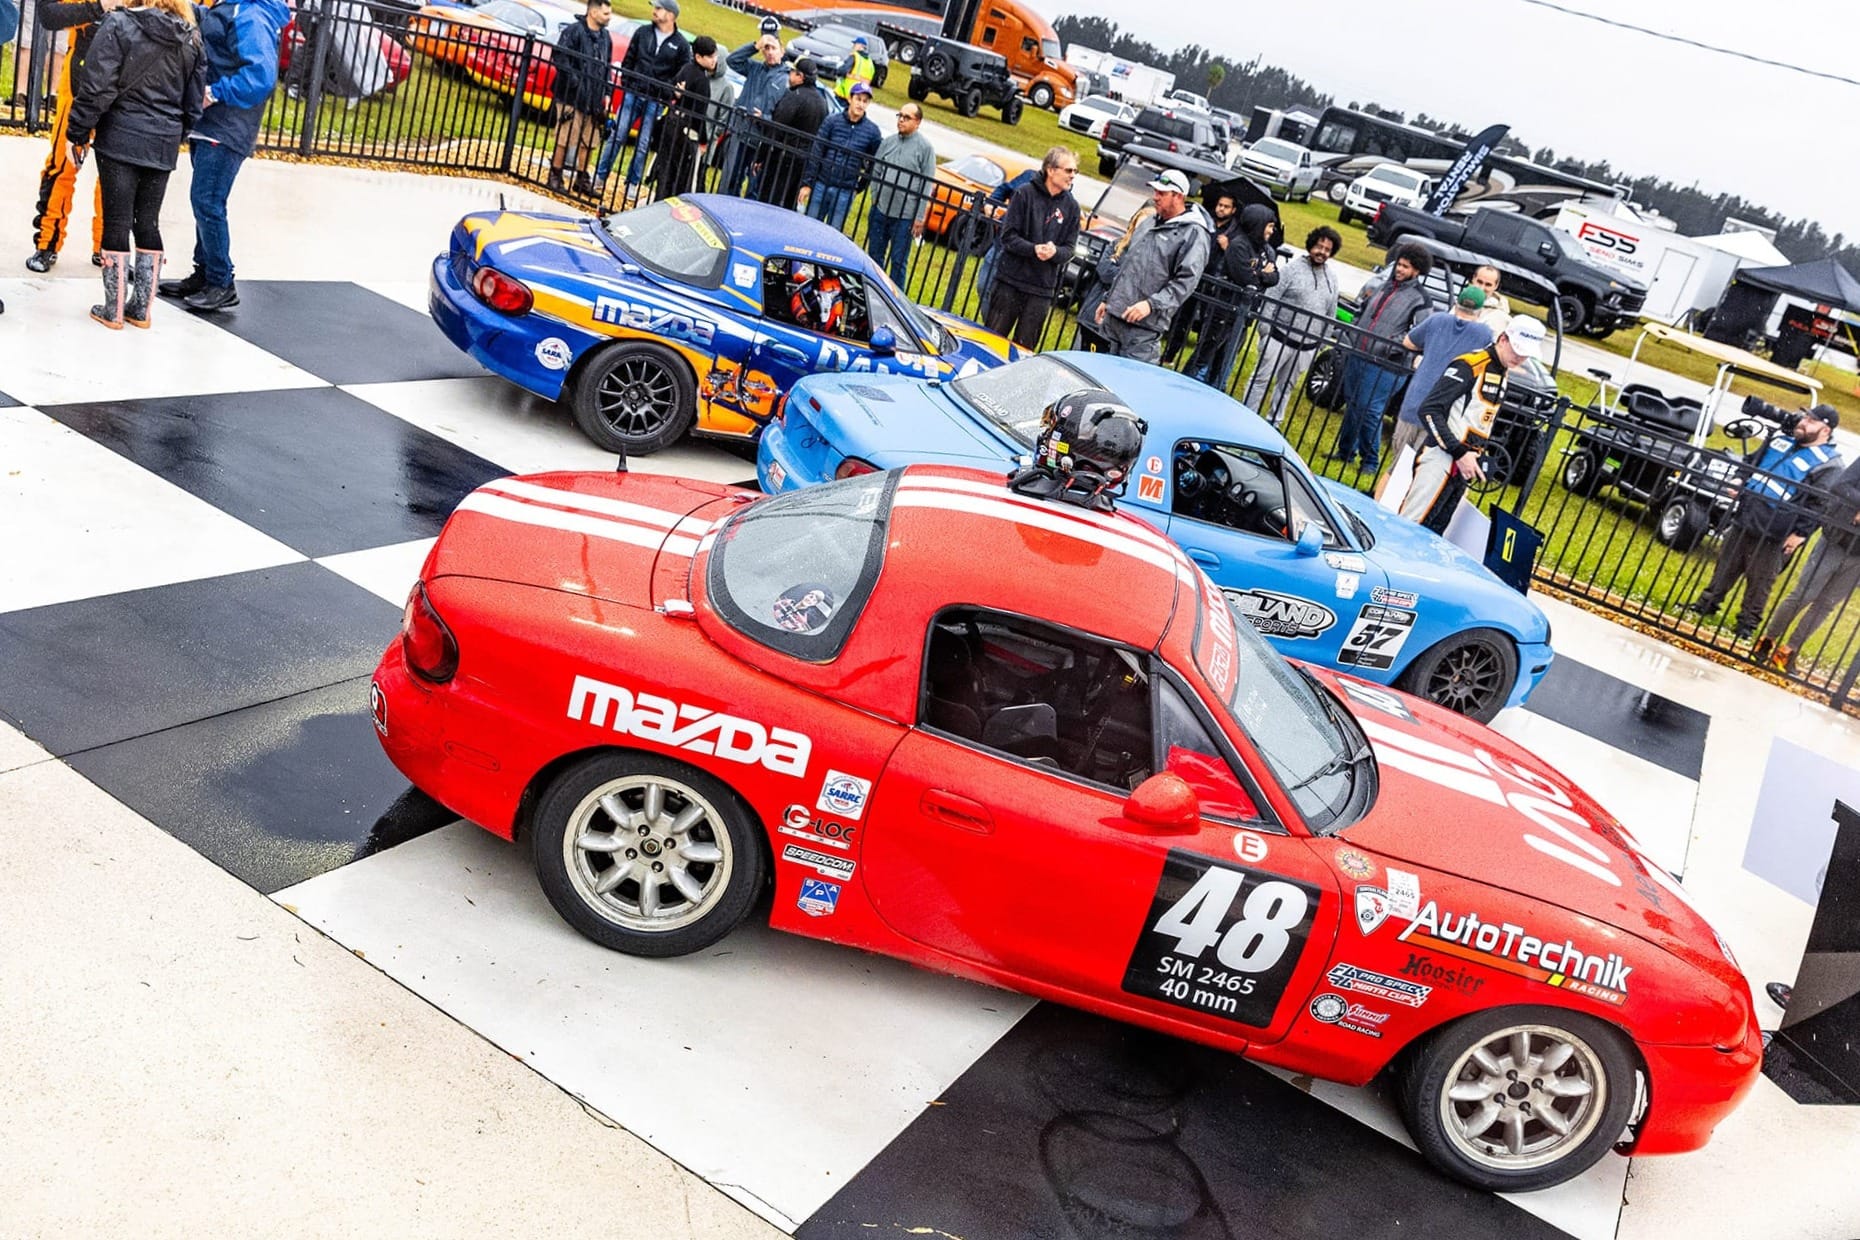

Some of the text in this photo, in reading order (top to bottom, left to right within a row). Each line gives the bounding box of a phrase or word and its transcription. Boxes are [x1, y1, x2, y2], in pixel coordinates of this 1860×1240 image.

[1433, 150, 1473, 200] RENTAL
[1351, 624, 1404, 650] 57
[784, 804, 856, 842] G-LOC
[1242, 834, 1260, 859] E
[1153, 865, 1309, 974] 48
[1397, 900, 1633, 993] AutoTechnik
[1157, 956, 1257, 995] SM 2465
[1359, 972, 1383, 984] PRO
[1384, 979, 1416, 993] SPEC
[1399, 953, 1485, 992] Hoosier
[1159, 978, 1238, 1013] 40 mm
[1352, 982, 1412, 1003] MIATA CUP
[1569, 981, 1619, 1001] RACING
[1337, 1020, 1356, 1031] ROAD
[1357, 1027, 1381, 1038] RACING
